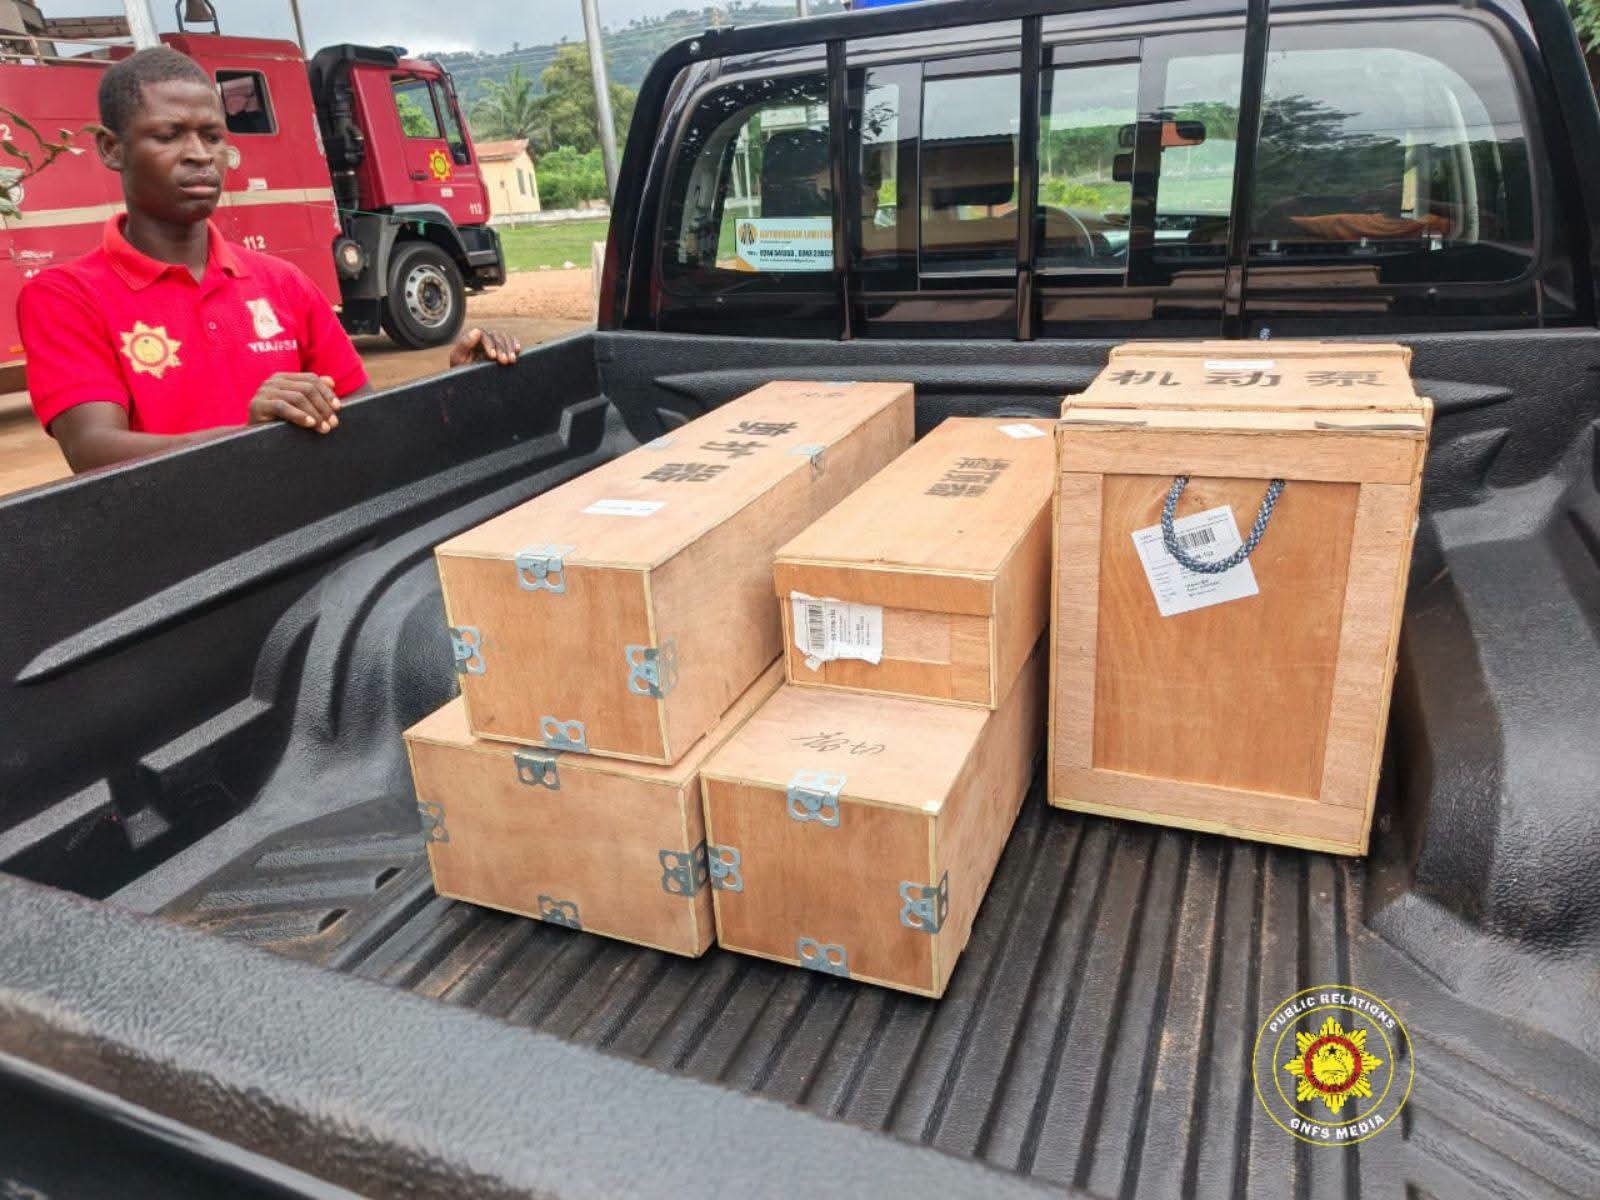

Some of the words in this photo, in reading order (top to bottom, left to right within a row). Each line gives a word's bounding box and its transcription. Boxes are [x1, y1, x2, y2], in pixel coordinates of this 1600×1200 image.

[242, 235, 266, 251] 112
[1108, 369, 1385, 388] 机动泵
